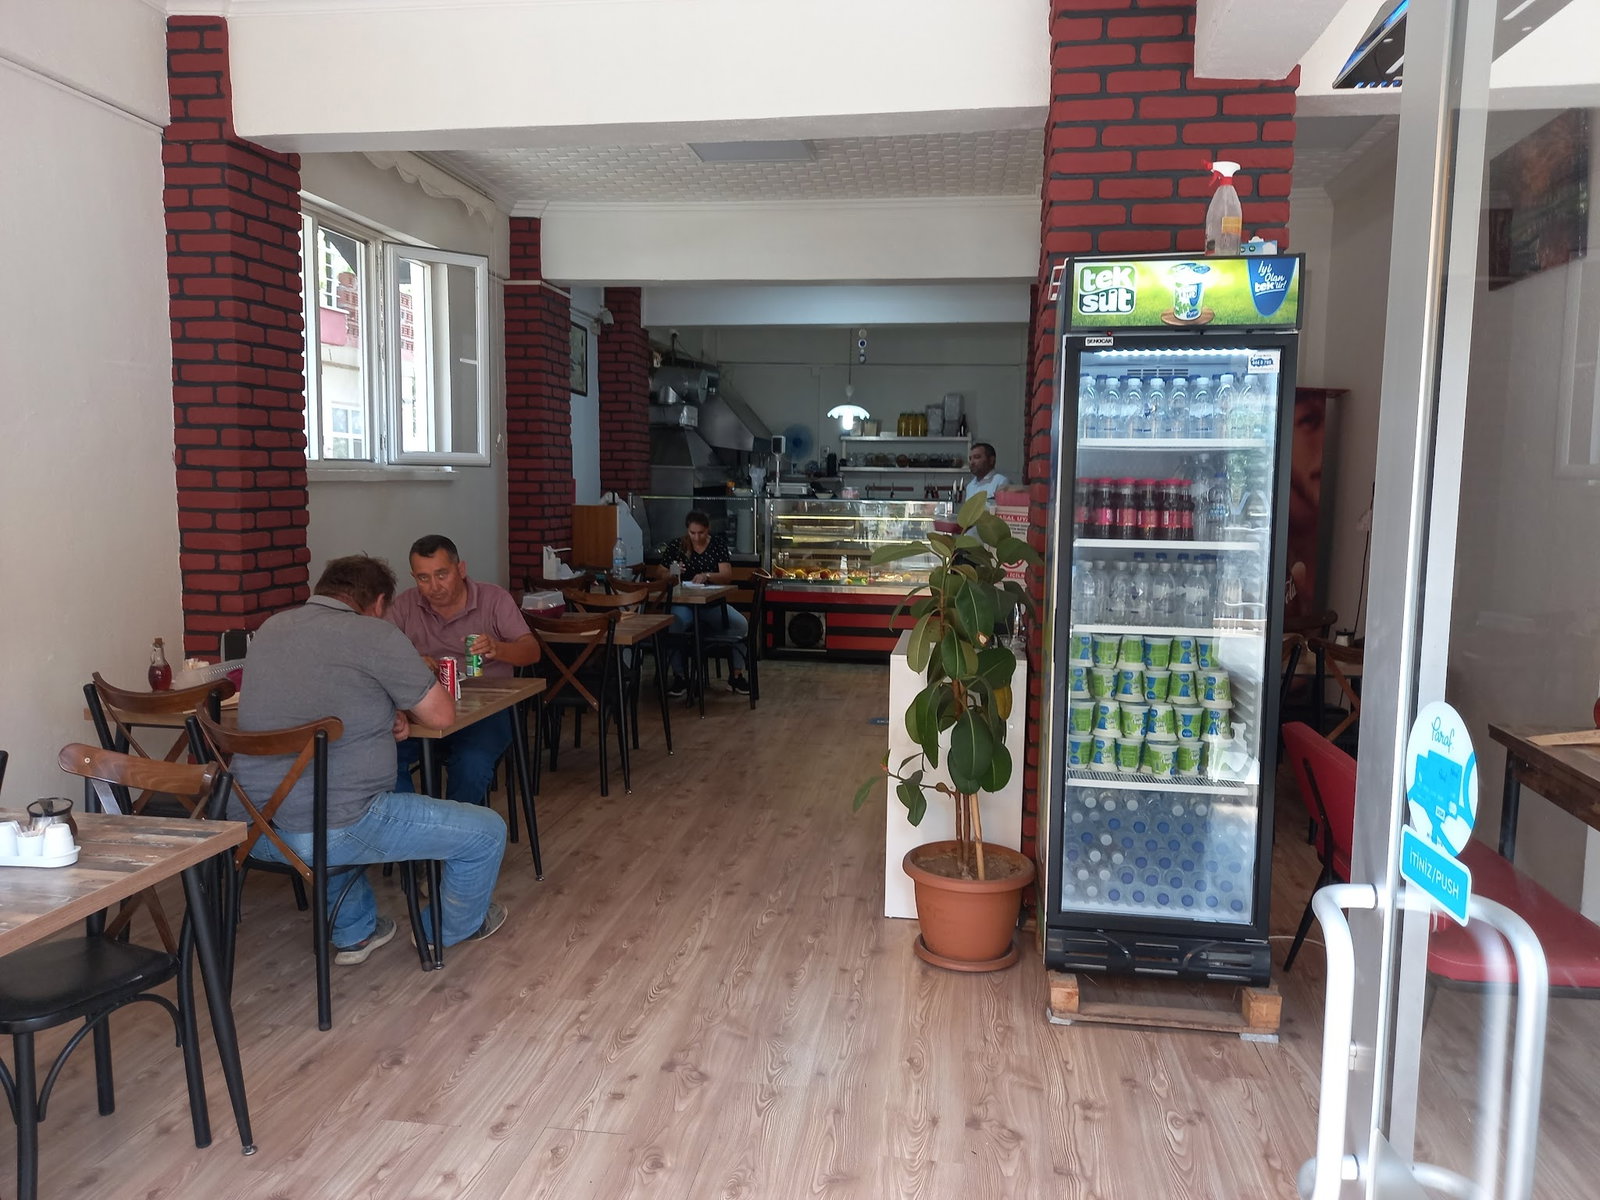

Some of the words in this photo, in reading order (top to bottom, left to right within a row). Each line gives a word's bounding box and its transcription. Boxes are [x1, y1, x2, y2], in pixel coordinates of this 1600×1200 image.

[1083, 266, 1133, 292] tek
[1264, 272, 1286, 282] Olan
[1082, 288, 1132, 312] süt
[1431, 716, 1455, 752] Paraf
